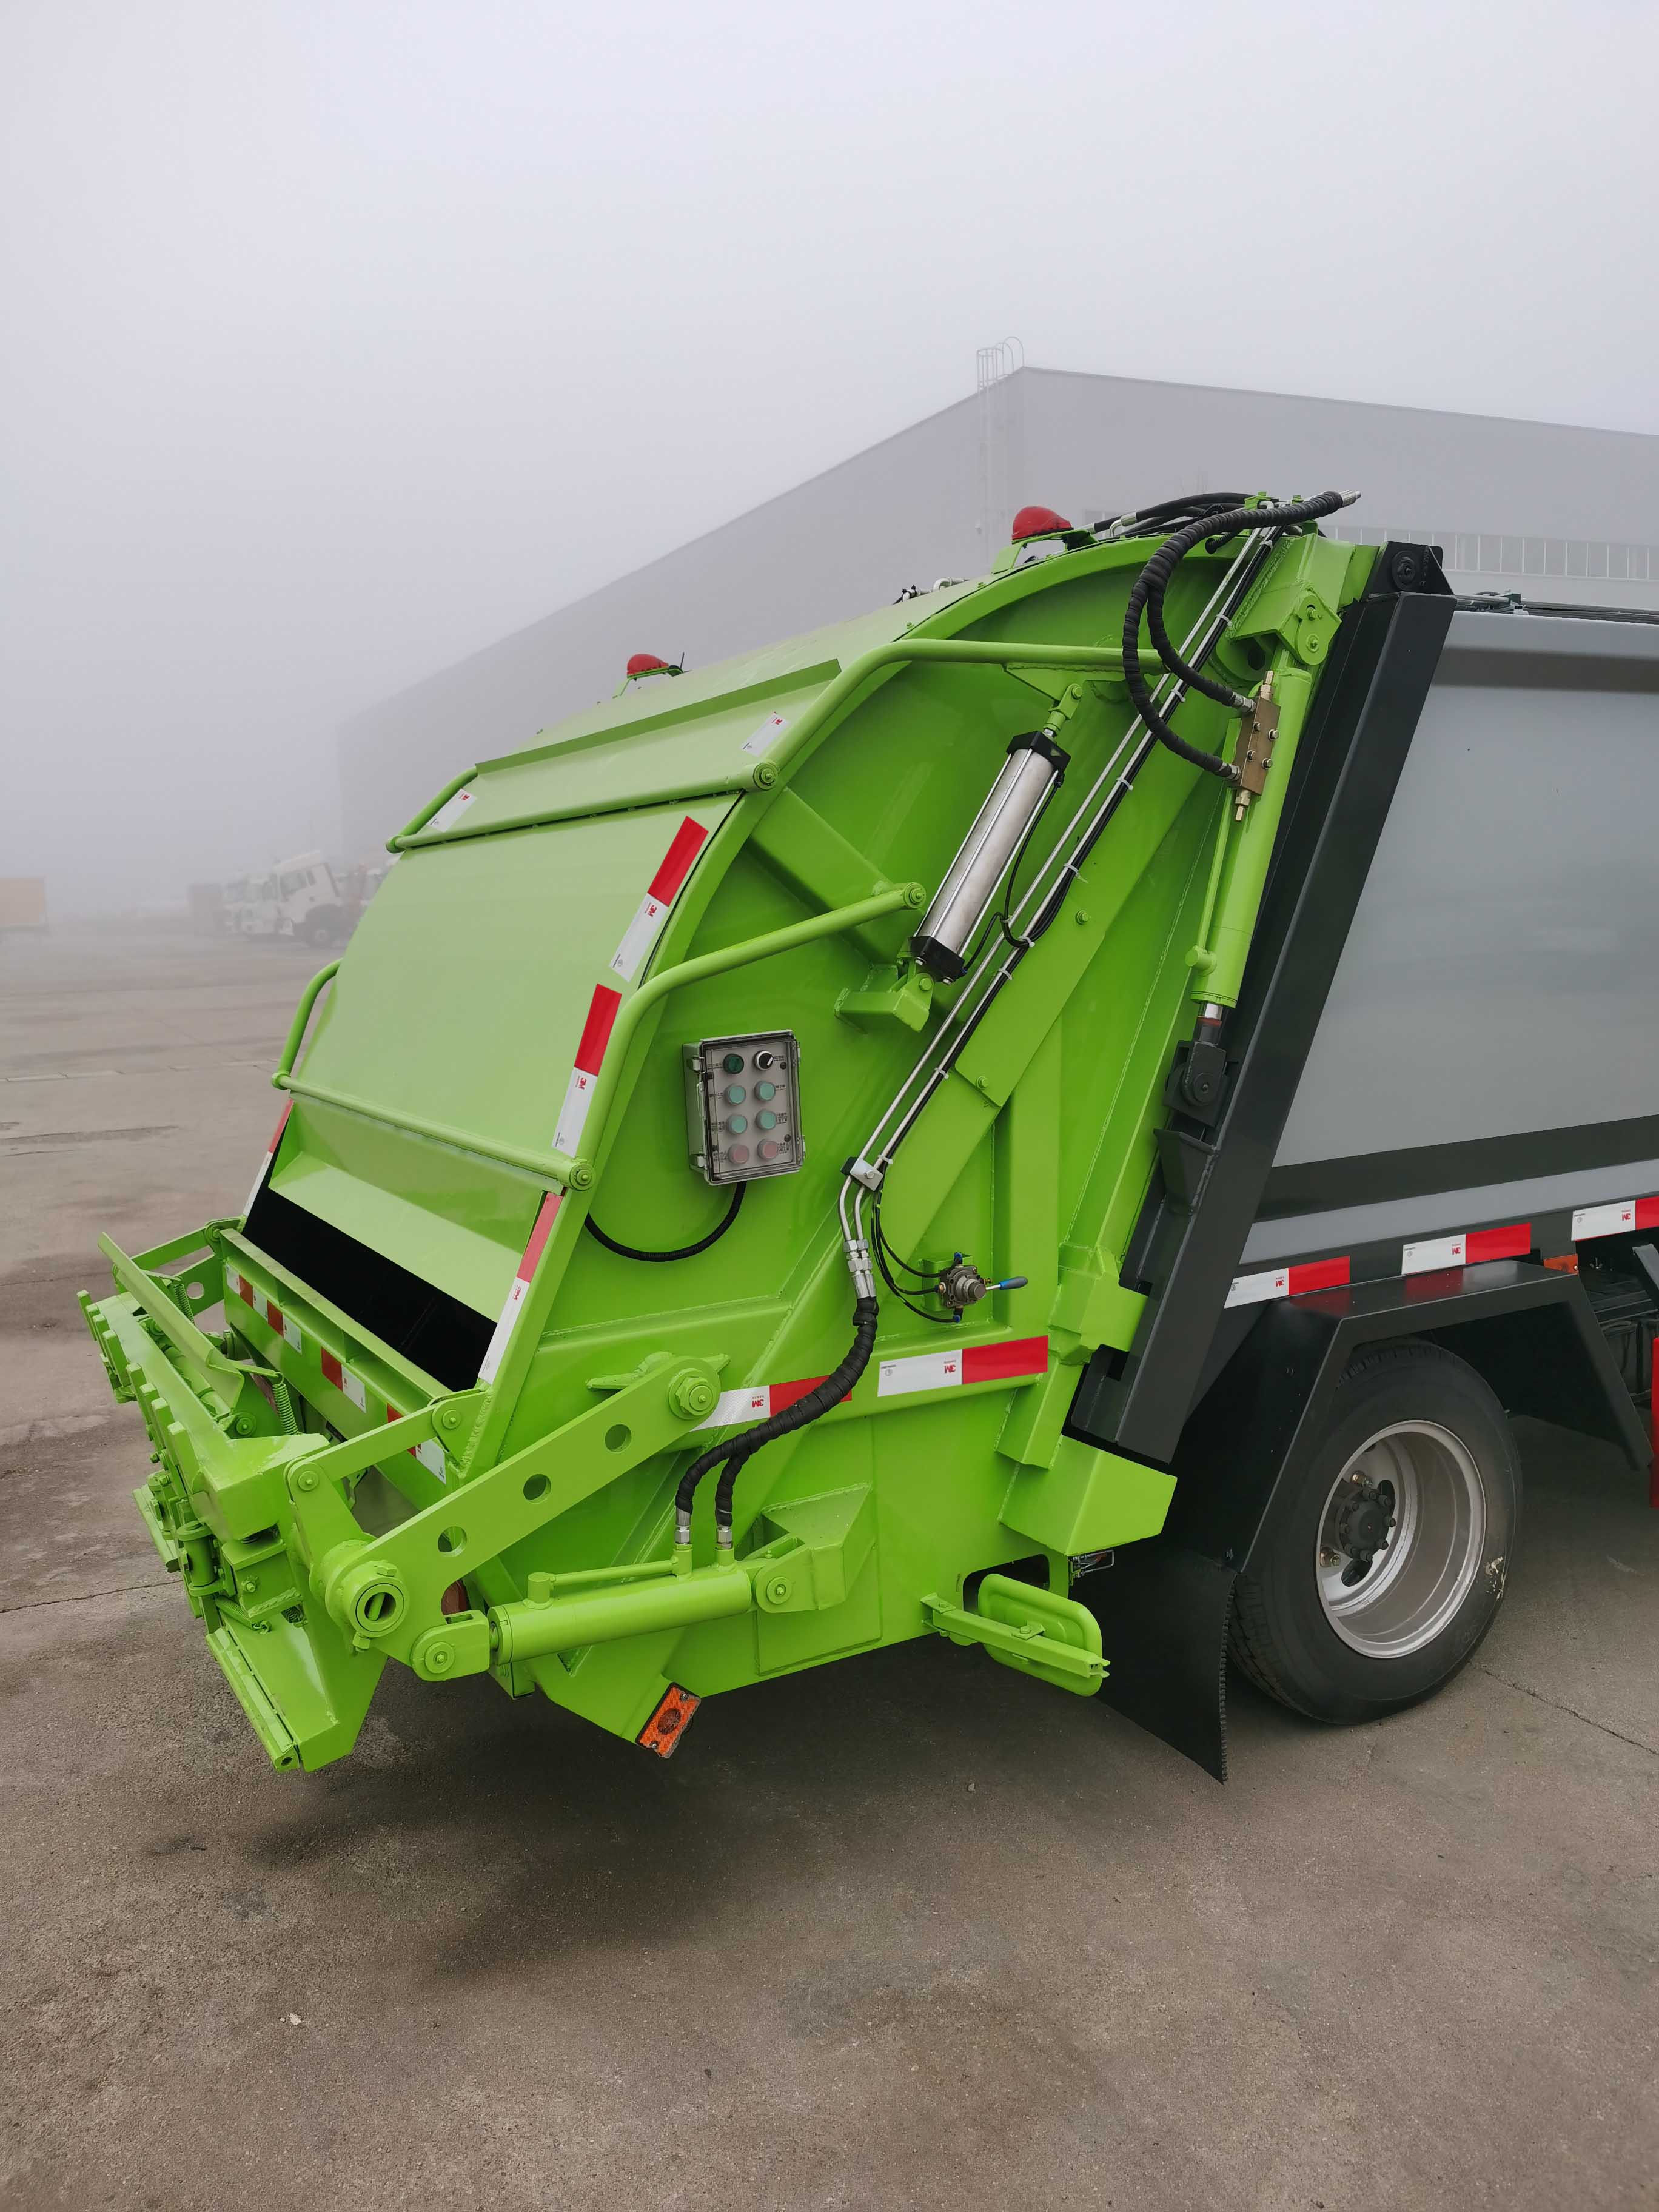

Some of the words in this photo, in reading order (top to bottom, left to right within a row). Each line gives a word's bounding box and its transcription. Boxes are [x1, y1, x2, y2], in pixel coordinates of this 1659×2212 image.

[647, 904, 657, 917] 3M
[578, 1076, 588, 1090] 3M
[944, 1364, 956, 1374] 3M
[752, 1399, 764, 1408] 3M
